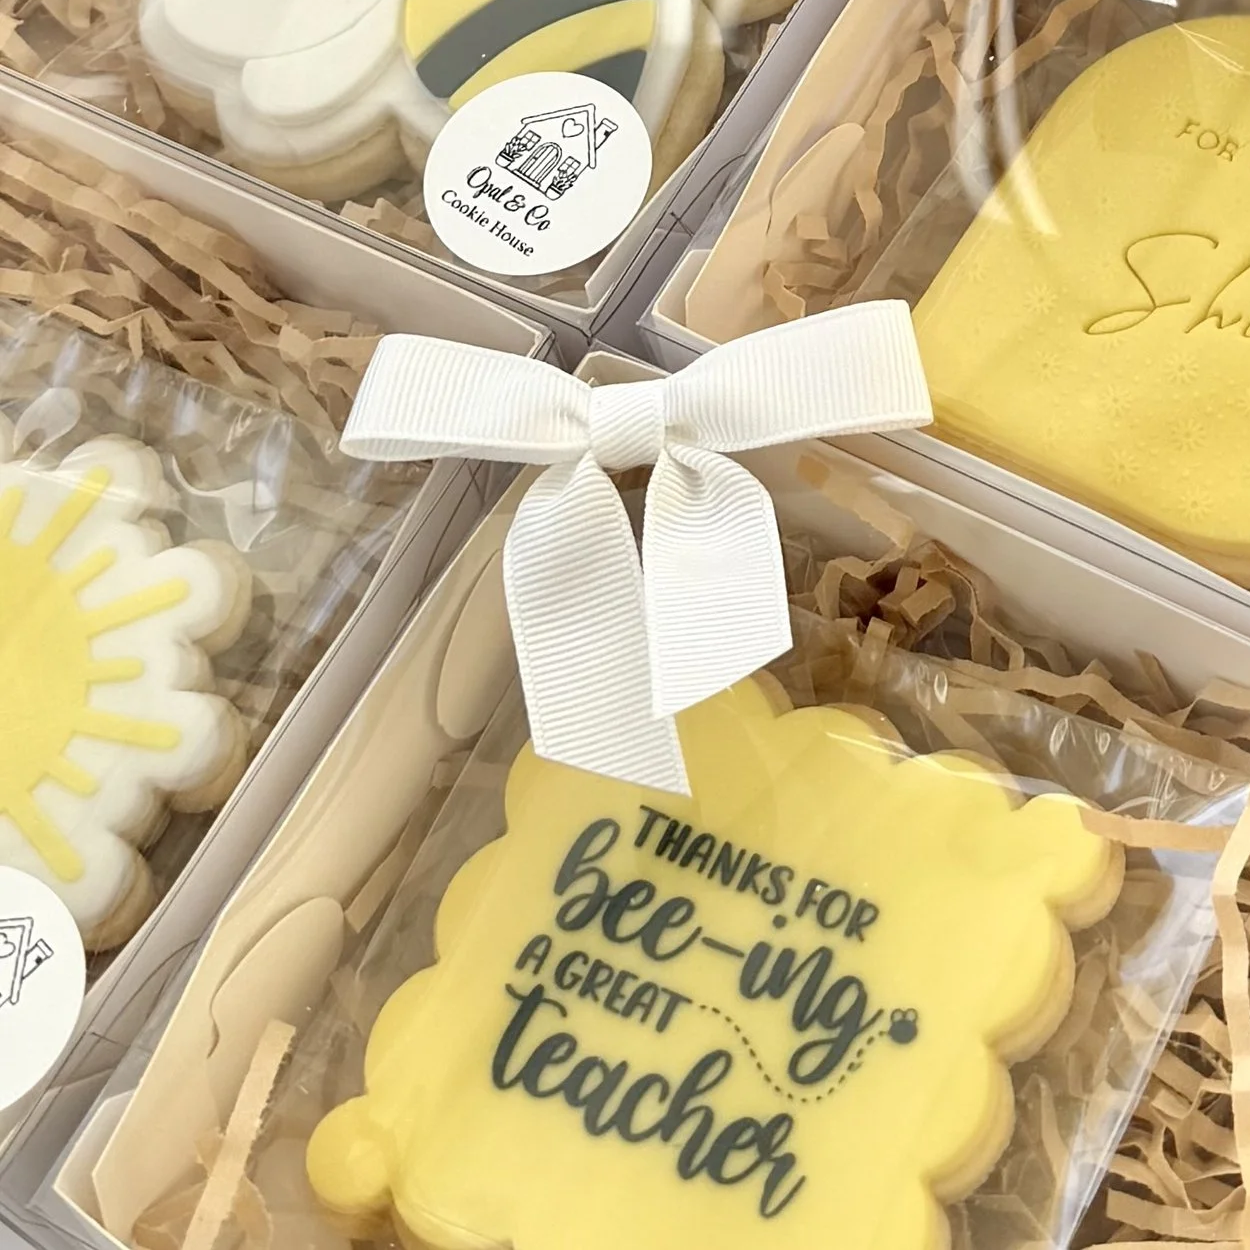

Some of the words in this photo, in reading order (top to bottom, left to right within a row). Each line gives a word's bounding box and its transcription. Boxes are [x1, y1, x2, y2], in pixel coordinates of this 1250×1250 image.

[1176, 119, 1241, 163] FOR
[441, 189, 490, 228] Cookie
[489, 220, 535, 257] House
[466, 166, 513, 203] Opal
[504, 195, 526, 212] &
[524, 204, 551, 232] Co
[633, 804, 796, 906] THANKS
[795, 877, 880, 943] FOR
[514, 933, 553, 976] A
[553, 949, 693, 1034] GREAT
[553, 817, 884, 1085] bee-ing
[491, 982, 807, 1220] teacher
